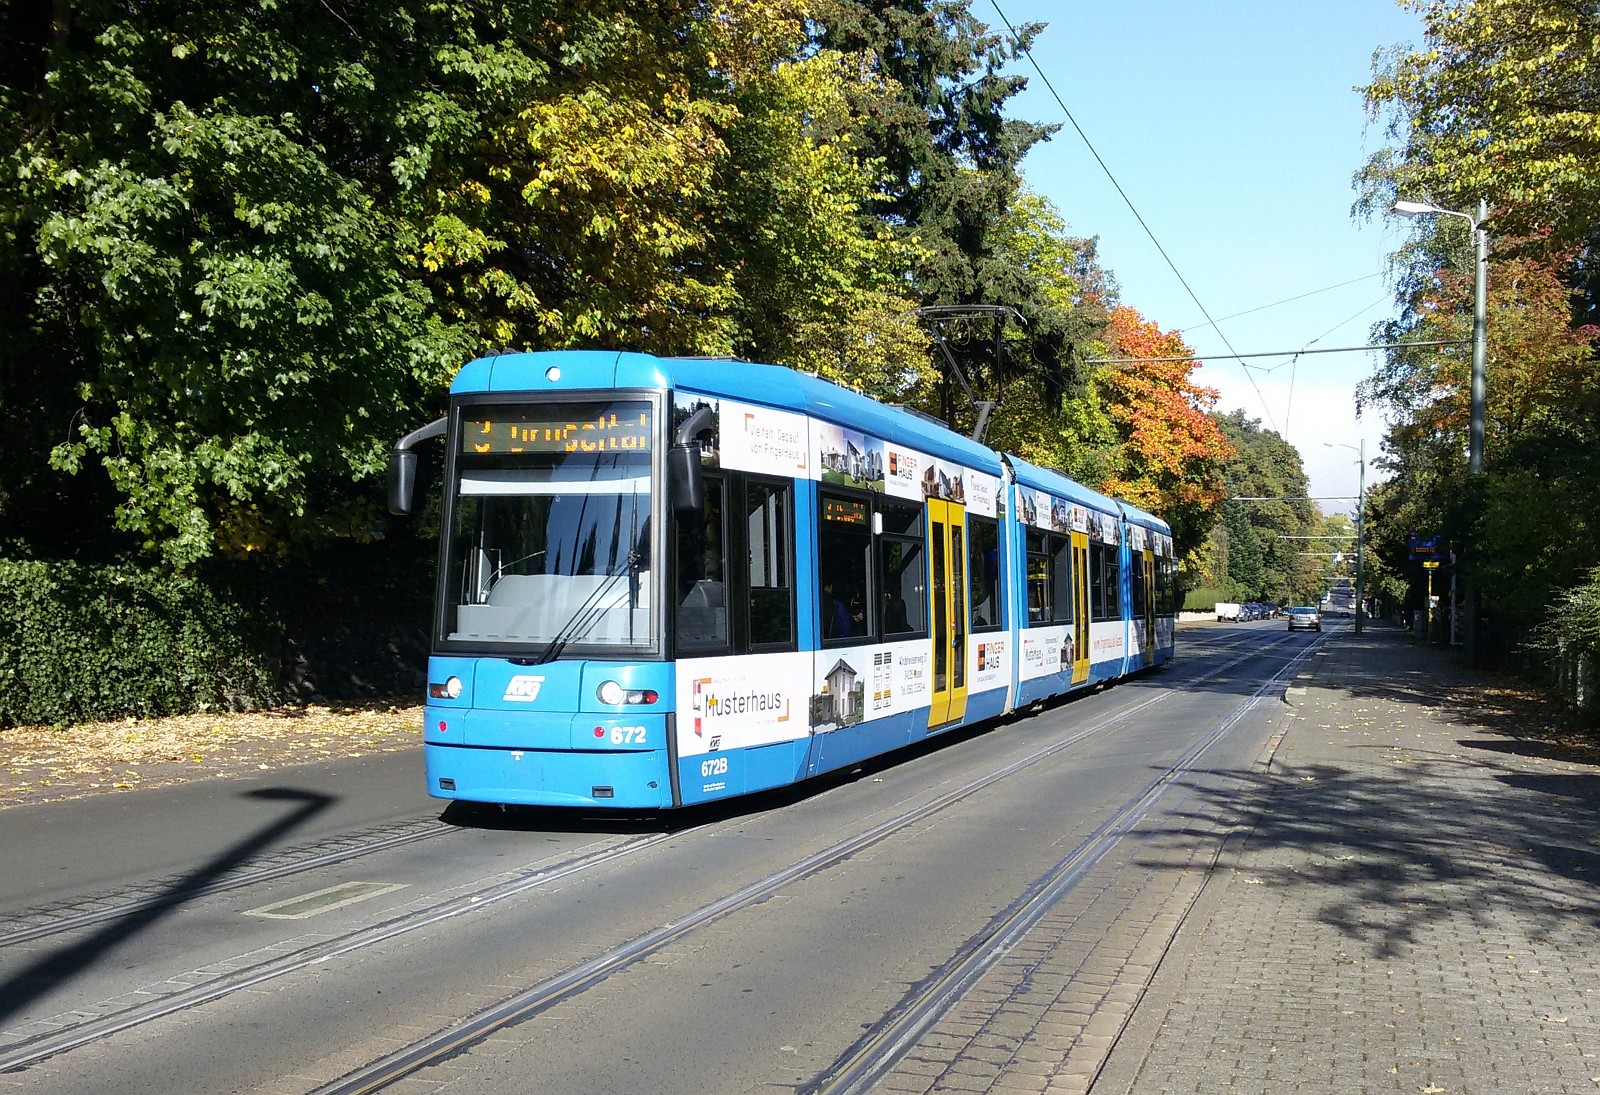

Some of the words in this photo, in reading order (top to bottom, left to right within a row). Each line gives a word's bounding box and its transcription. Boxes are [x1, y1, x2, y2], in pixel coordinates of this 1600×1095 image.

[898, 453, 917, 469] FINGER
[898, 467, 913, 480] HAUS
[986, 641, 1004, 656] FINGER
[986, 656, 1000, 670] HAUS
[705, 689, 782, 718] Musterhaus
[610, 725, 647, 744] 672
[701, 757, 728, 777] 672B
